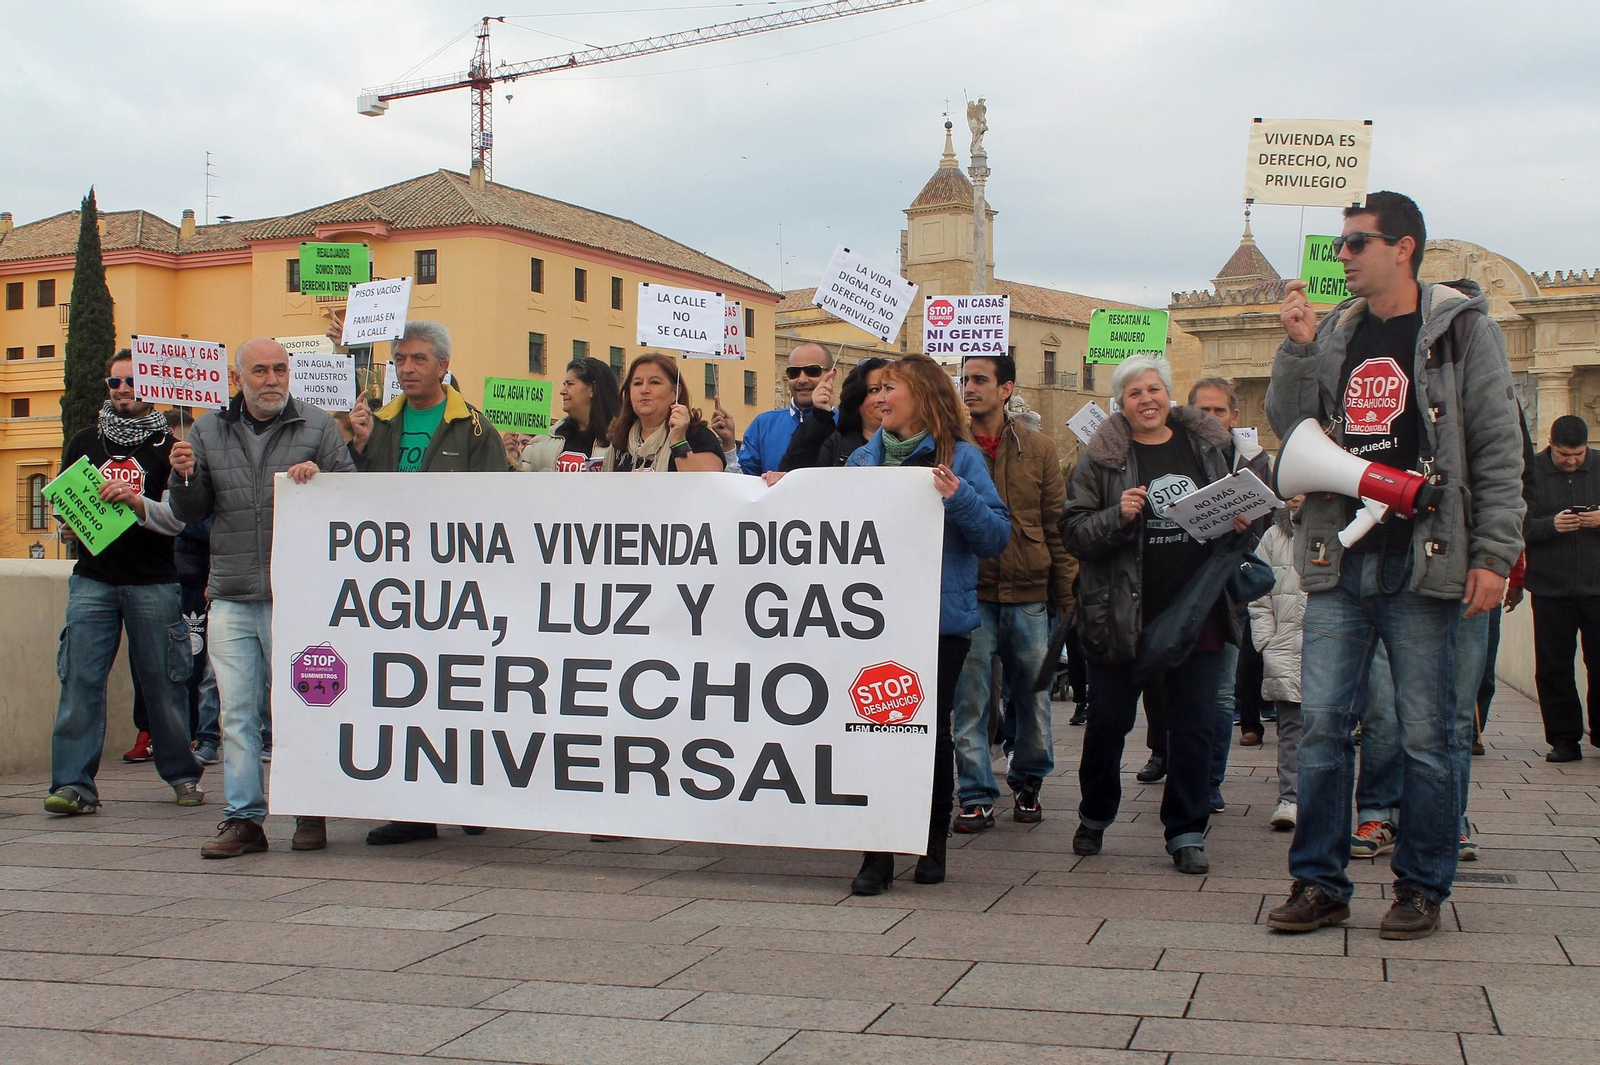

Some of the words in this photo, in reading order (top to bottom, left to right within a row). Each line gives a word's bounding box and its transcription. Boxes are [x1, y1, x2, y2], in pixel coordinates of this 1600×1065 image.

[1265, 133, 1334, 146] VIVIENDA
[1340, 134, 1356, 147] ES
[1258, 154, 1330, 169] DERECHO,
[1336, 156, 1358, 168] NO
[1266, 174, 1346, 188] PRIVILEGIO
[317, 248, 350, 258] REALOJADOS
[1310, 244, 1320, 260] NI
[316, 264, 334, 275] SOMOS
[334, 265, 352, 275] TODOS
[856, 264, 867, 276] LA
[870, 270, 891, 288] VIDA
[302, 280, 325, 291] DERECHO
[326, 281, 331, 291] A
[332, 282, 348, 291] TENER
[355, 288, 374, 298] PISOS
[376, 284, 401, 296] VACÍOS
[838, 270, 868, 292] DIGNA
[870, 288, 882, 298] ES
[883, 294, 898, 306] UN
[1308, 276, 1318, 293] NI
[1320, 277, 1348, 296] GENTE
[658, 292, 670, 303] LA
[674, 295, 706, 308] CALLE
[831, 283, 876, 313] DERECHO,
[878, 307, 893, 320] NO
[958, 299, 968, 308] NI
[971, 299, 1004, 307] CASAS
[352, 314, 384, 325] FAMILIAS
[386, 312, 395, 320] EN
[673, 311, 690, 322] NO
[824, 295, 838, 308] UN
[839, 303, 890, 334] PRIVILEGIO
[930, 306, 953, 316] STOP
[958, 316, 971, 324] SIN
[974, 315, 1003, 326] GENTE,
[1108, 314, 1141, 325] RESCATAN
[1142, 315, 1150, 325] AL
[357, 329, 366, 338] LA
[367, 327, 387, 336] CALLE
[658, 325, 670, 335] SE
[674, 328, 707, 340] CALLA
[928, 330, 943, 339] NI
[949, 329, 1003, 339] GENTE
[1110, 331, 1145, 342] BANQUERO
[137, 342, 158, 357] LUZ,
[161, 344, 187, 357] AGUA
[190, 346, 196, 358] Y
[200, 348, 218, 360] GAS
[927, 342, 954, 352] SIN
[960, 342, 1003, 352] CASA
[1090, 348, 1125, 359] DESAHUCIA
[297, 360, 309, 368] SIN
[311, 360, 334, 369] AGUA,
[138, 363, 220, 382] DERECHO
[295, 372, 307, 380] LUZ
[309, 373, 347, 381] NUESTROS
[140, 385, 221, 403] UNIVERSAL
[493, 384, 506, 400] LUZ,
[507, 385, 524, 400] AGUA
[526, 387, 530, 400] Y
[531, 387, 543, 402] GAS
[1348, 376, 1400, 398] STOP
[327, 398, 347, 406] VIVIR
[1346, 398, 1396, 408] DESAHUCIOS
[514, 412, 547, 428] UNIVERSAL
[103, 468, 139, 483] STOP
[1153, 480, 1189, 505] STOP
[1194, 500, 1211, 510] NO
[1211, 488, 1235, 502] MÁS
[82, 486, 90, 494] Y
[89, 495, 106, 515] GAS
[1189, 508, 1220, 525] CASAS
[1220, 490, 1260, 510] VACÍAS,
[65, 487, 103, 531] DERECHO
[1198, 524, 1211, 532] NI
[1212, 518, 1220, 526] A
[1221, 498, 1266, 522] OSCURAS
[51, 492, 97, 545] UNIVERSAL
[328, 520, 410, 563] POR
[430, 522, 515, 564] UNA
[534, 523, 718, 566] VIVIENDA
[738, 520, 885, 566] DIGNA
[328, 578, 508, 647] AGUA,
[538, 582, 651, 636] LUZ
[677, 584, 715, 636] Y
[745, 582, 885, 640] GAS
[303, 654, 336, 666] STOP
[372, 651, 829, 726] DERECHO
[857, 675, 913, 704] STOP
[863, 694, 918, 715] DESAHUCIOS
[849, 724, 870, 733] 15M
[873, 724, 925, 734] CÓRDOBA
[339, 723, 868, 806] UNIVERSAL
